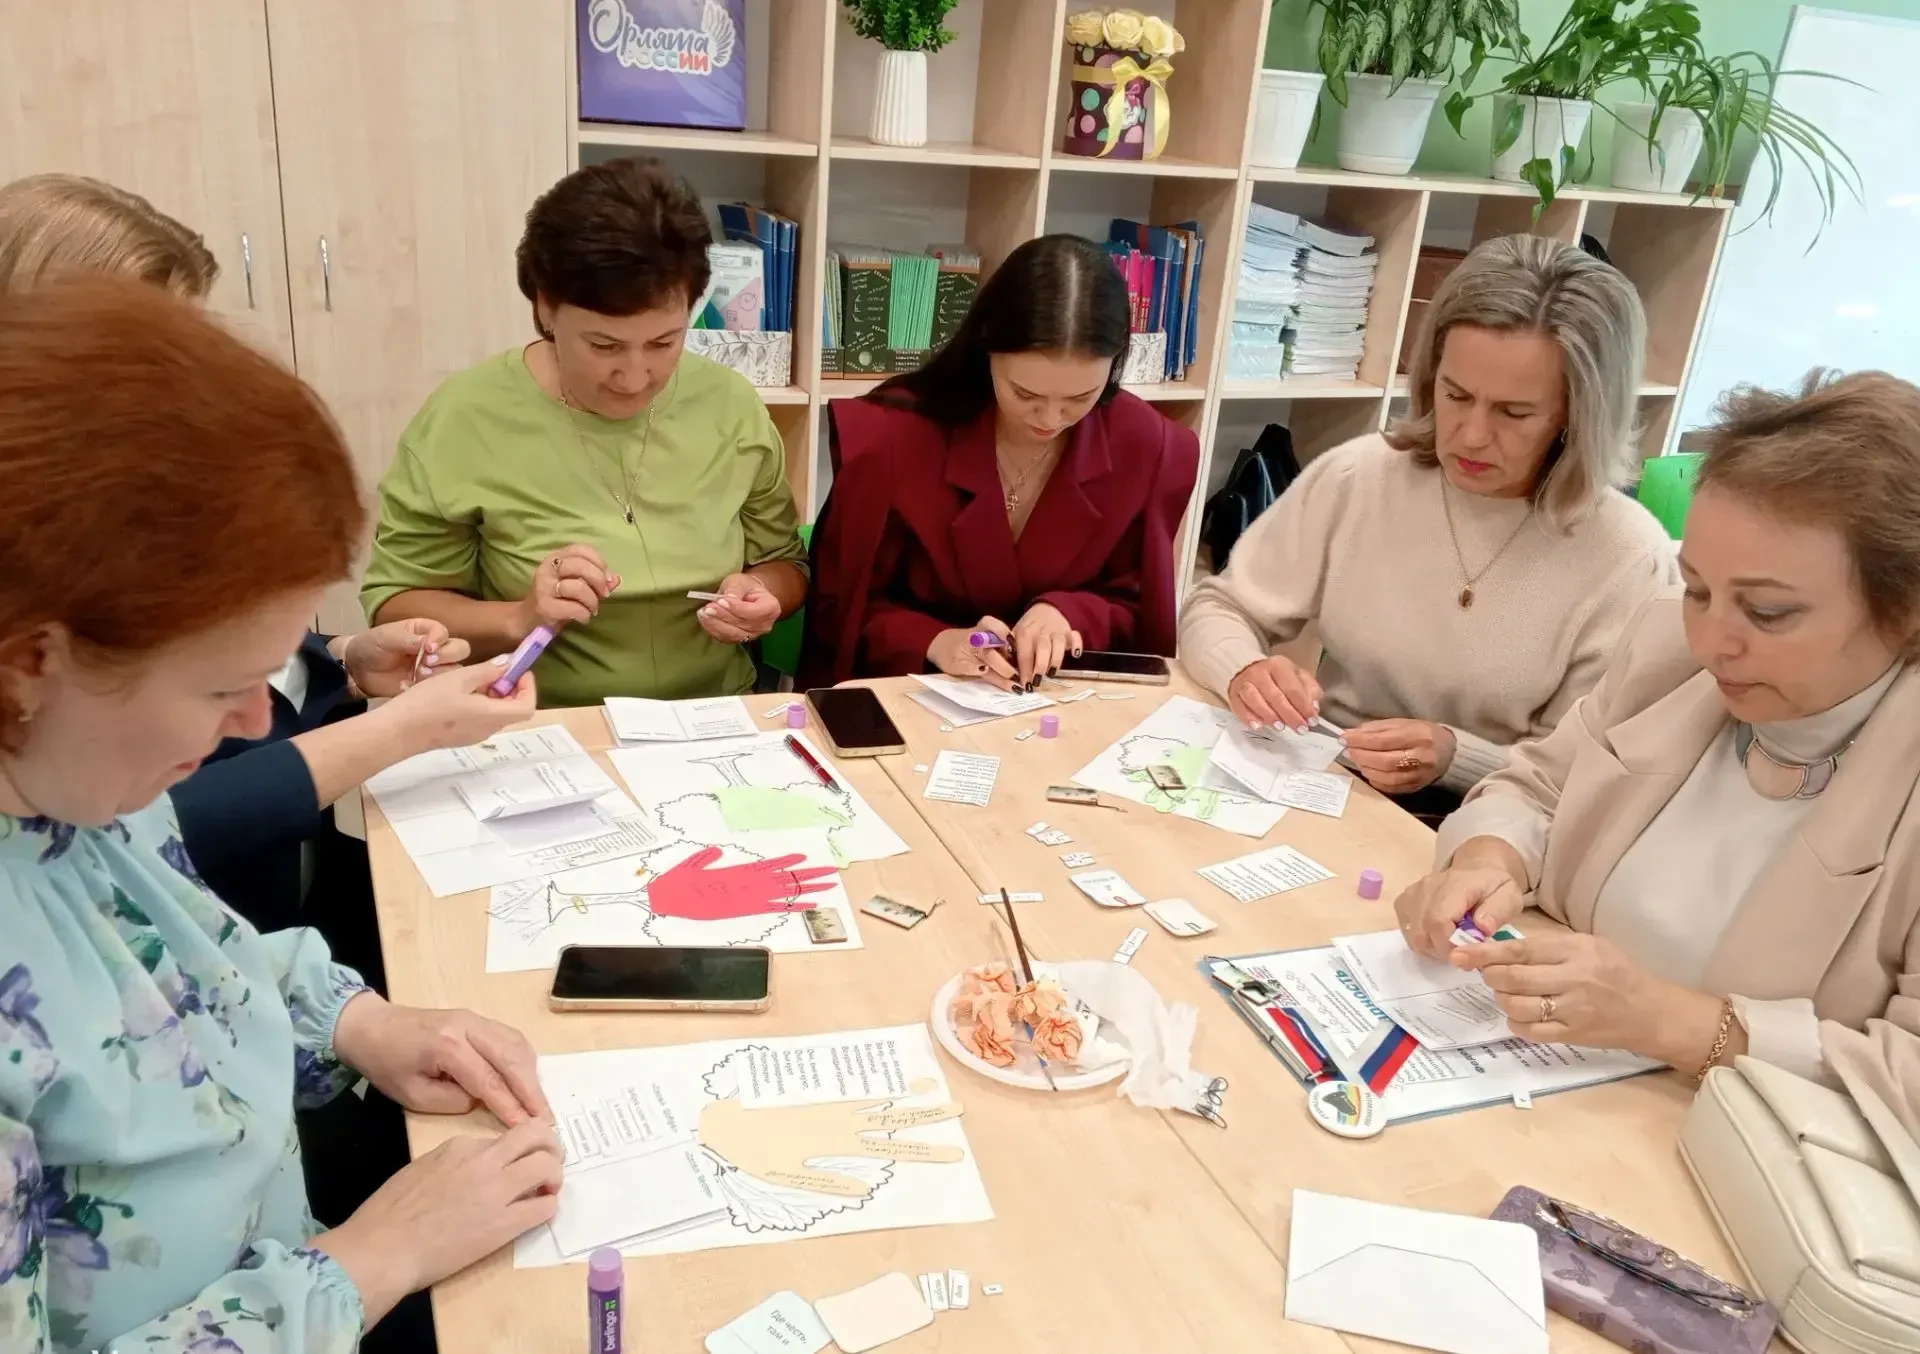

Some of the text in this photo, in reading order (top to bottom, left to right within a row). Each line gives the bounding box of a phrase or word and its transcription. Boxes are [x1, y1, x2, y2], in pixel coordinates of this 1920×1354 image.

[592, 0, 709, 54] Орлята
[621, 50, 709, 72] РОССИИ
[604, 1311, 617, 1351] berlingo
[766, 1325, 790, 1346] там и
[770, 1309, 807, 1344] Где честь,
